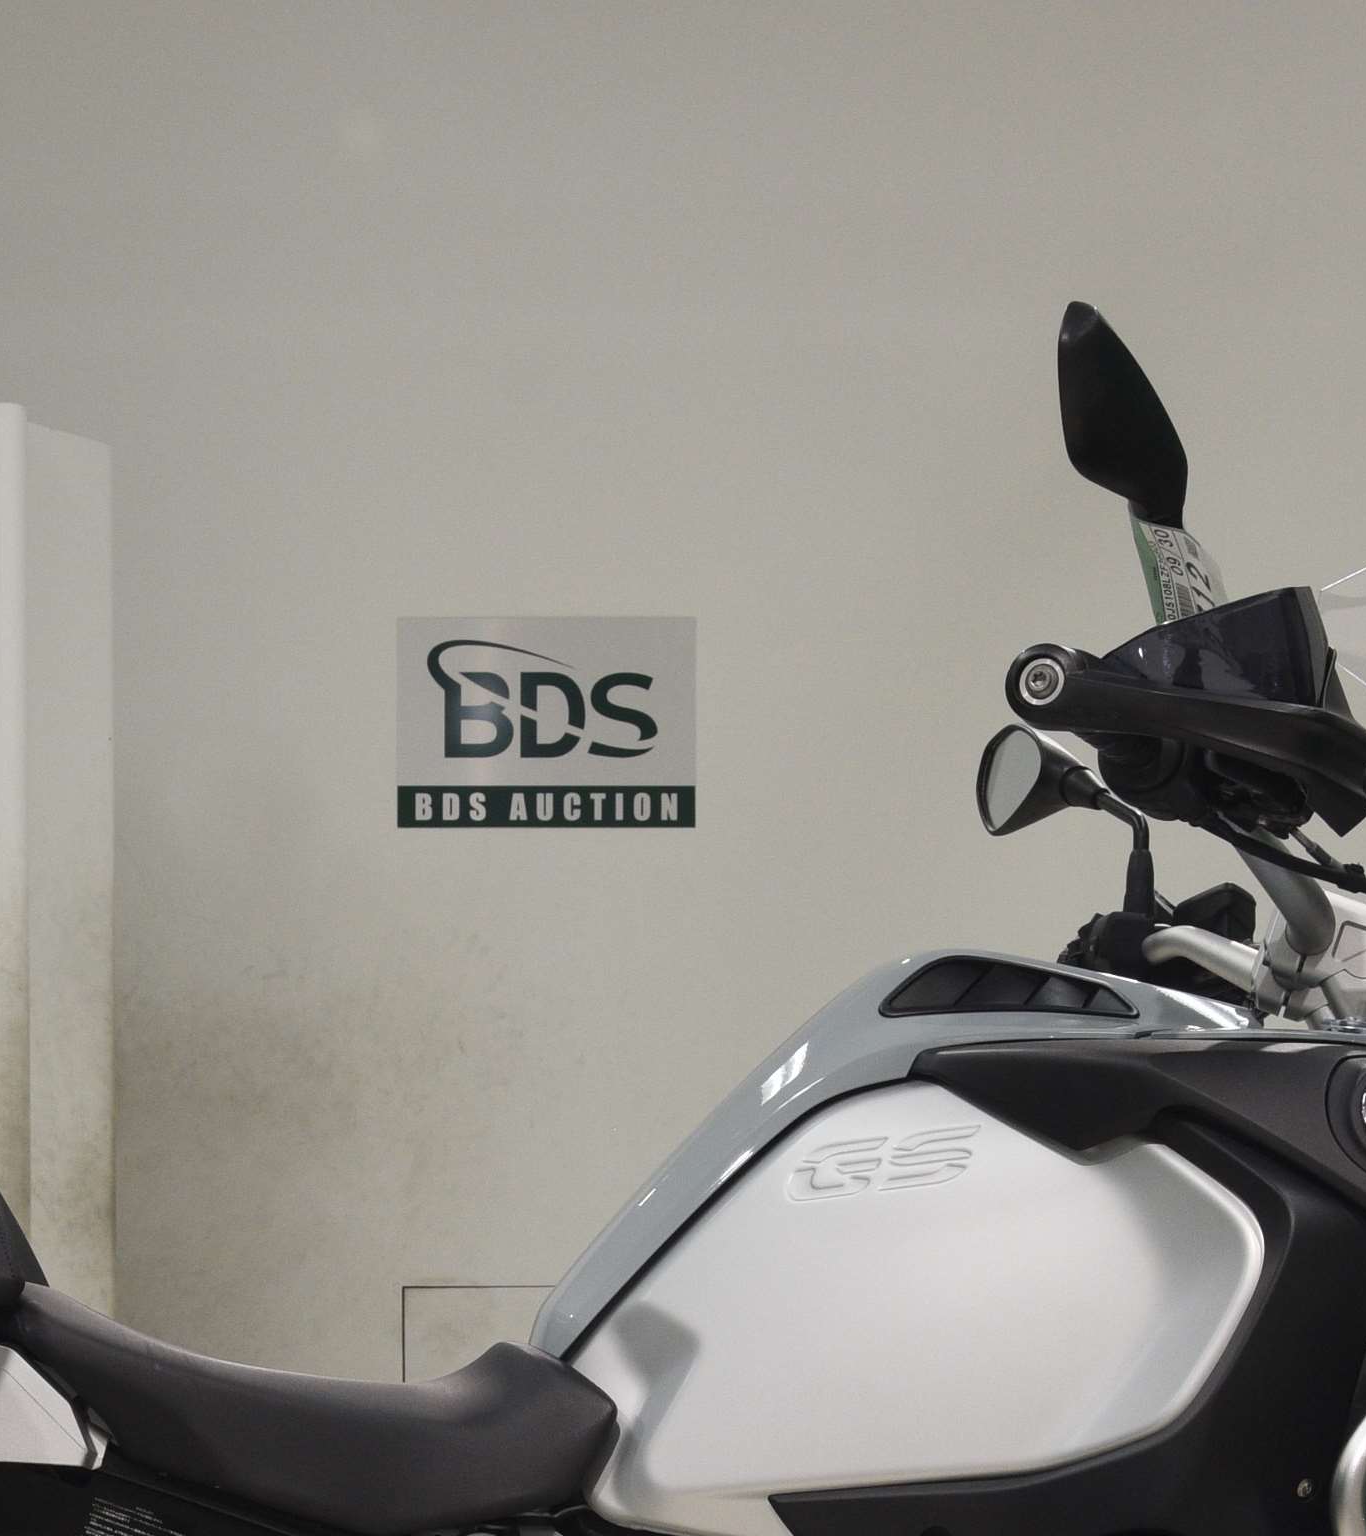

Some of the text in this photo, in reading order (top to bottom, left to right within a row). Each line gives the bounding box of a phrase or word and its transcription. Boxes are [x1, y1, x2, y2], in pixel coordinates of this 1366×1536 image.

[427, 640, 658, 758] BDS
[414, 793, 679, 822] BDS AUCTION
[786, 1124, 982, 1202] GS
